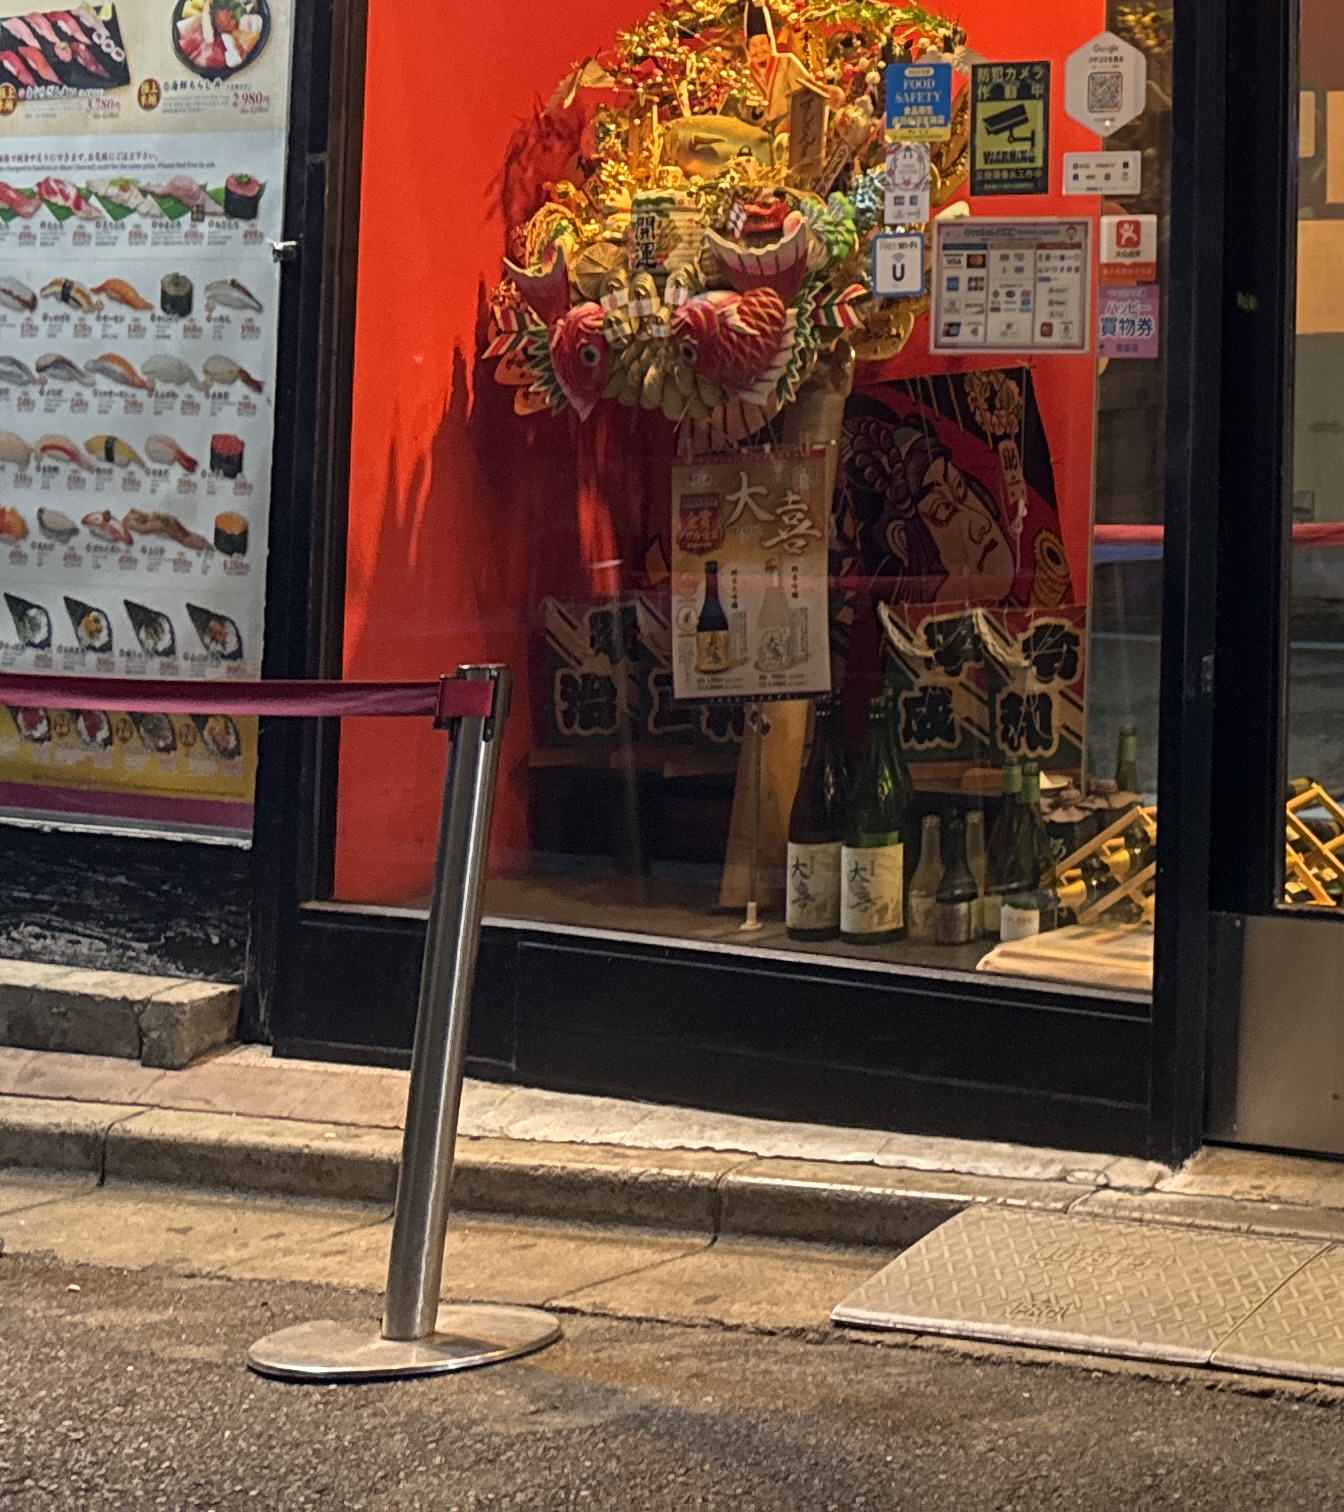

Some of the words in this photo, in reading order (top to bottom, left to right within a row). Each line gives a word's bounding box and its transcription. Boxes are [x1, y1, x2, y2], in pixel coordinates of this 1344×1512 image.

[978, 65, 1044, 83] 防犯カメラ
[903, 78, 936, 90] FOOD
[895, 90, 943, 103] SAFETY
[983, 150, 1036, 165] WARNING
[898, 241, 918, 249] Wi-Fi
[1105, 300, 1151, 314] ハッピー
[1100, 316, 1153, 337] 買物券
[725, 471, 822, 556] 大喜
